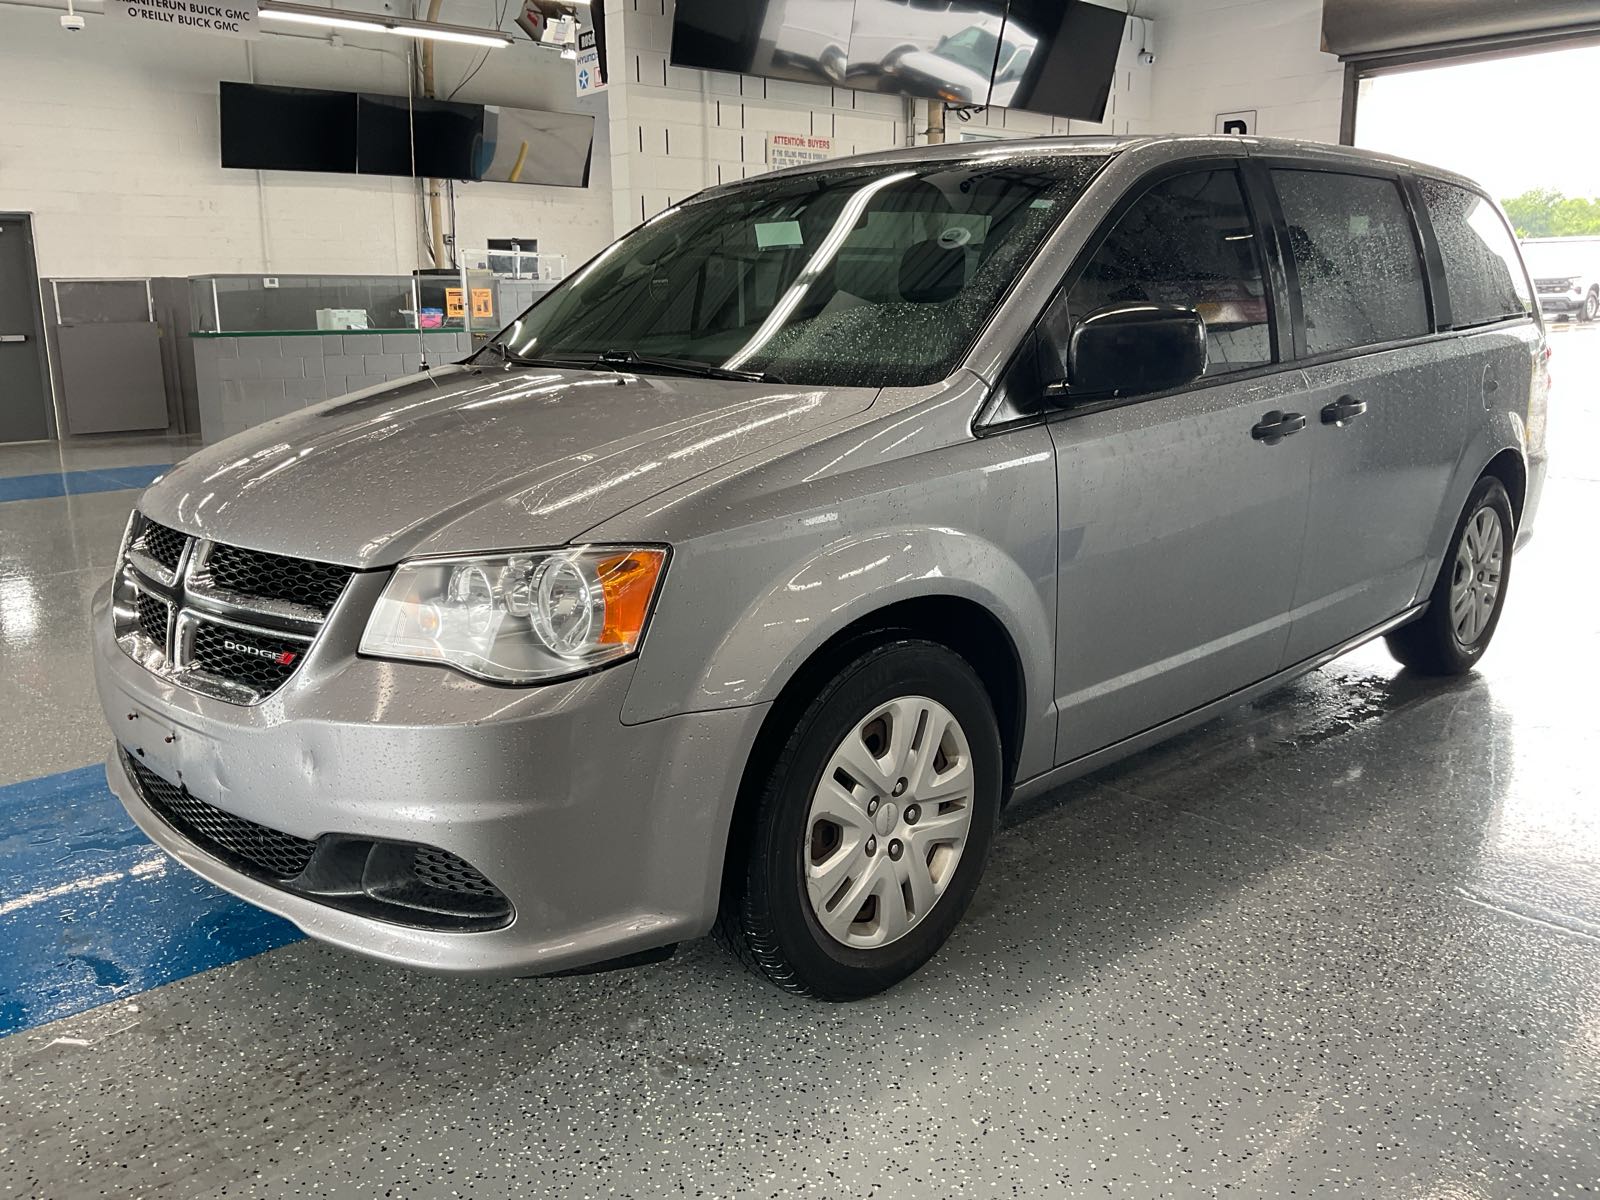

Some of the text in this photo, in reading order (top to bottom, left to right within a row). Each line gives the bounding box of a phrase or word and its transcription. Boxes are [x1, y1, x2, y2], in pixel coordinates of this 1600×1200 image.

[115, 0, 250, 21] NITERUN BUICK GMC
[128, 7, 239, 32] O'REILLY BUICK GMC
[577, 53, 598, 65] HYUND
[774, 136, 830, 149] ATTENTION: BUYERS
[224, 640, 284, 660] DODGE
